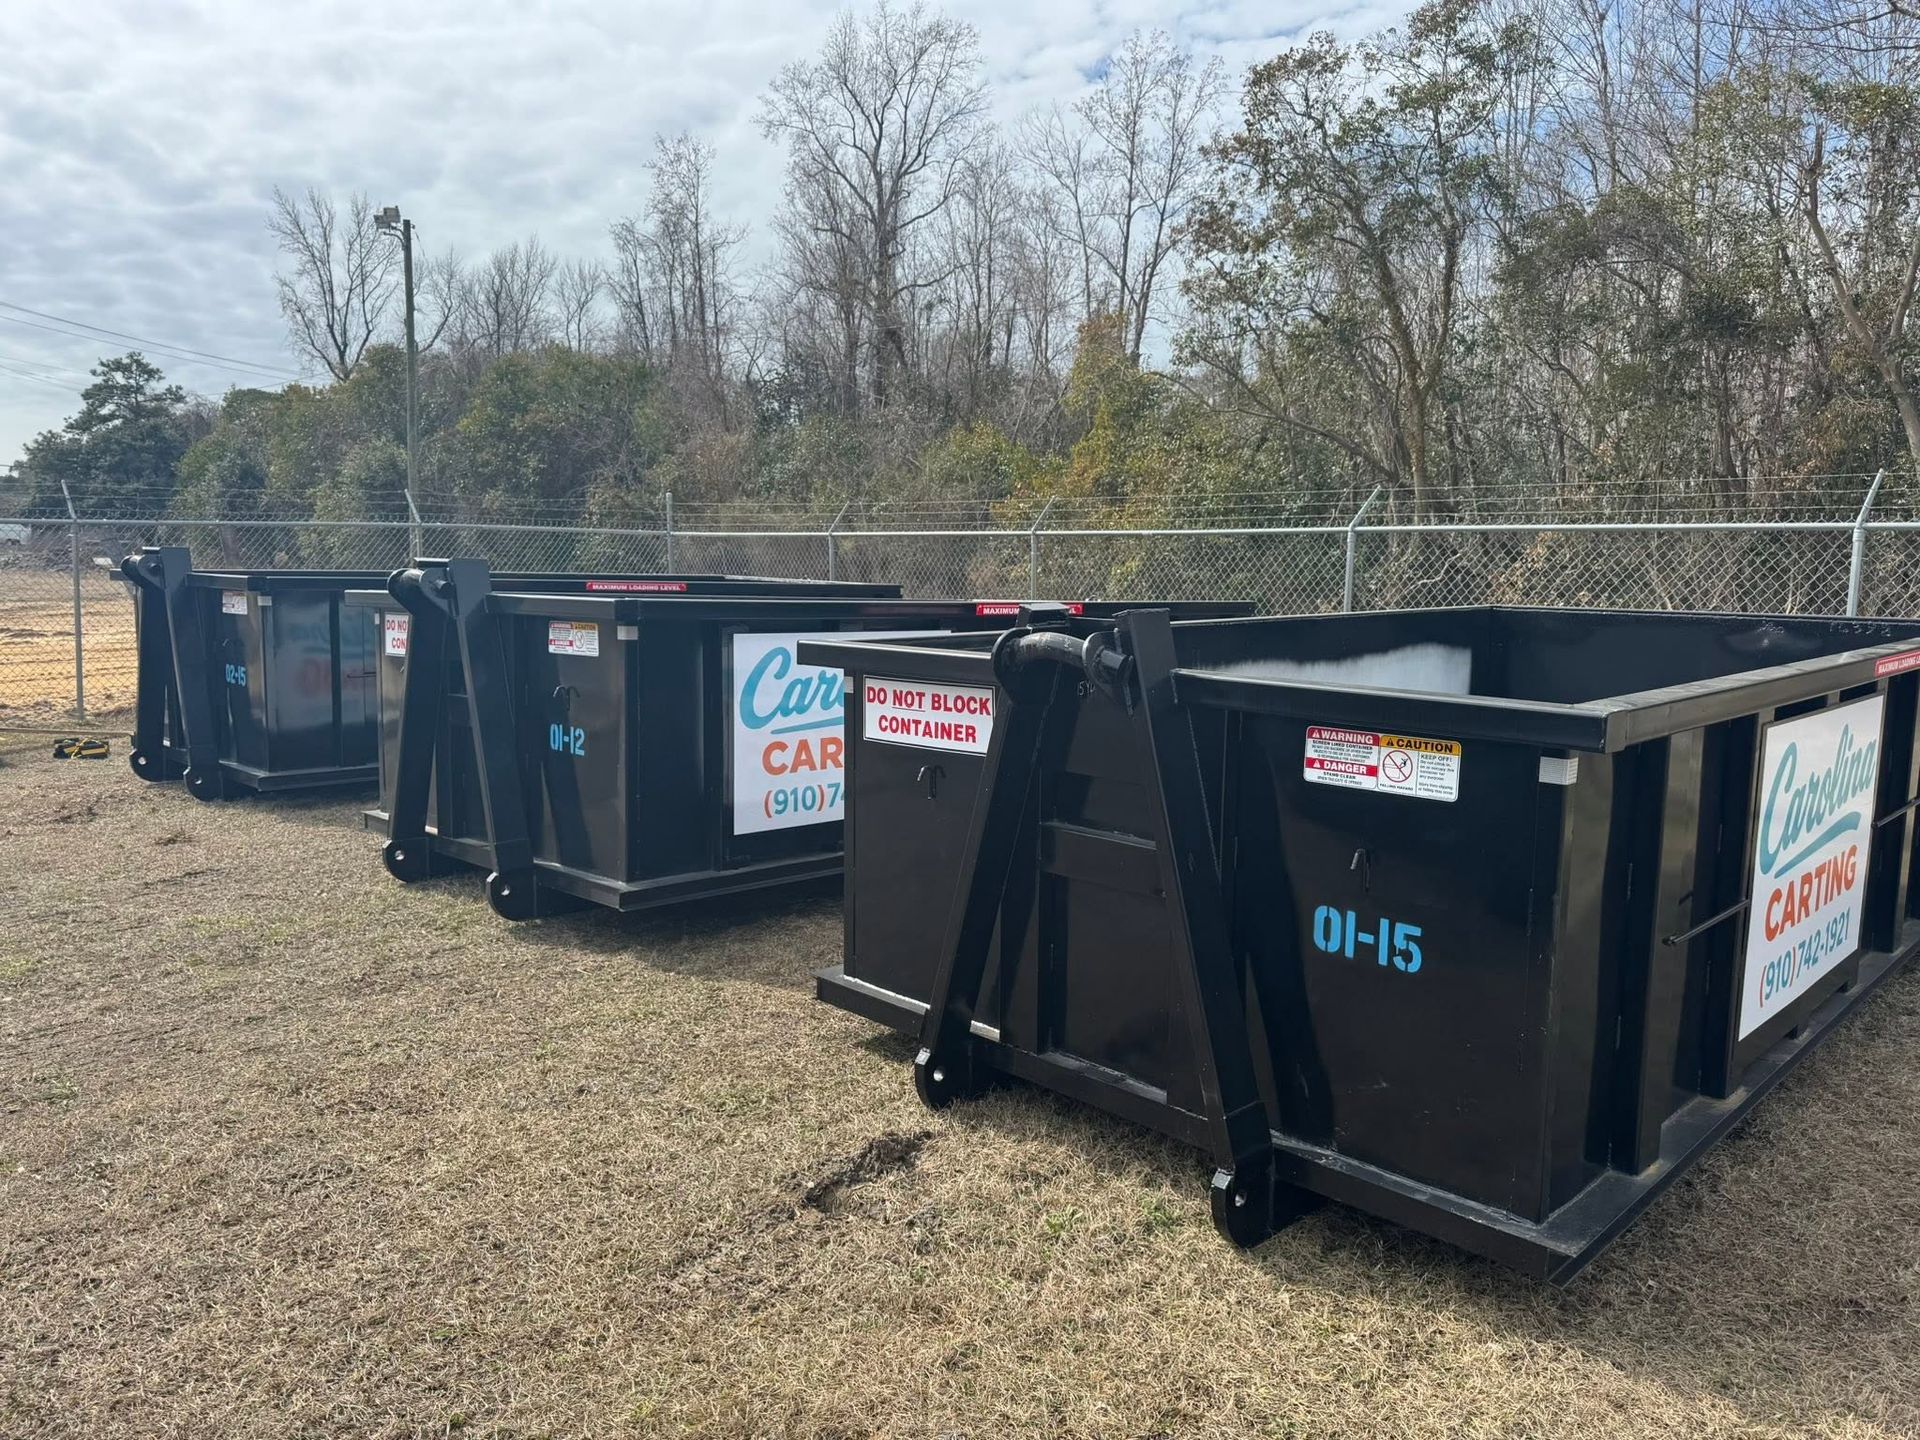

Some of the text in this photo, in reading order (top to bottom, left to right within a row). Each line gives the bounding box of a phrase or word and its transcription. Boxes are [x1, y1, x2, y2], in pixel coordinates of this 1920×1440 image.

[386, 619, 396, 631] DO
[983, 607, 1020, 615] MAXIMUM
[225, 663, 247, 687] 02-15
[866, 686, 991, 716] DO NOT BLOCK
[550, 723, 585, 757] 01-12
[878, 714, 977, 744] CONTAINER
[1321, 729, 1373, 744] WARNING
[1396, 738, 1453, 754] CAUTION
[1323, 761, 1367, 774] DANGER
[764, 782, 845, 818] (910)7
[1759, 723, 1877, 876] Carolina
[1764, 845, 1858, 942] CARTING
[1313, 905, 1422, 974] 01-15
